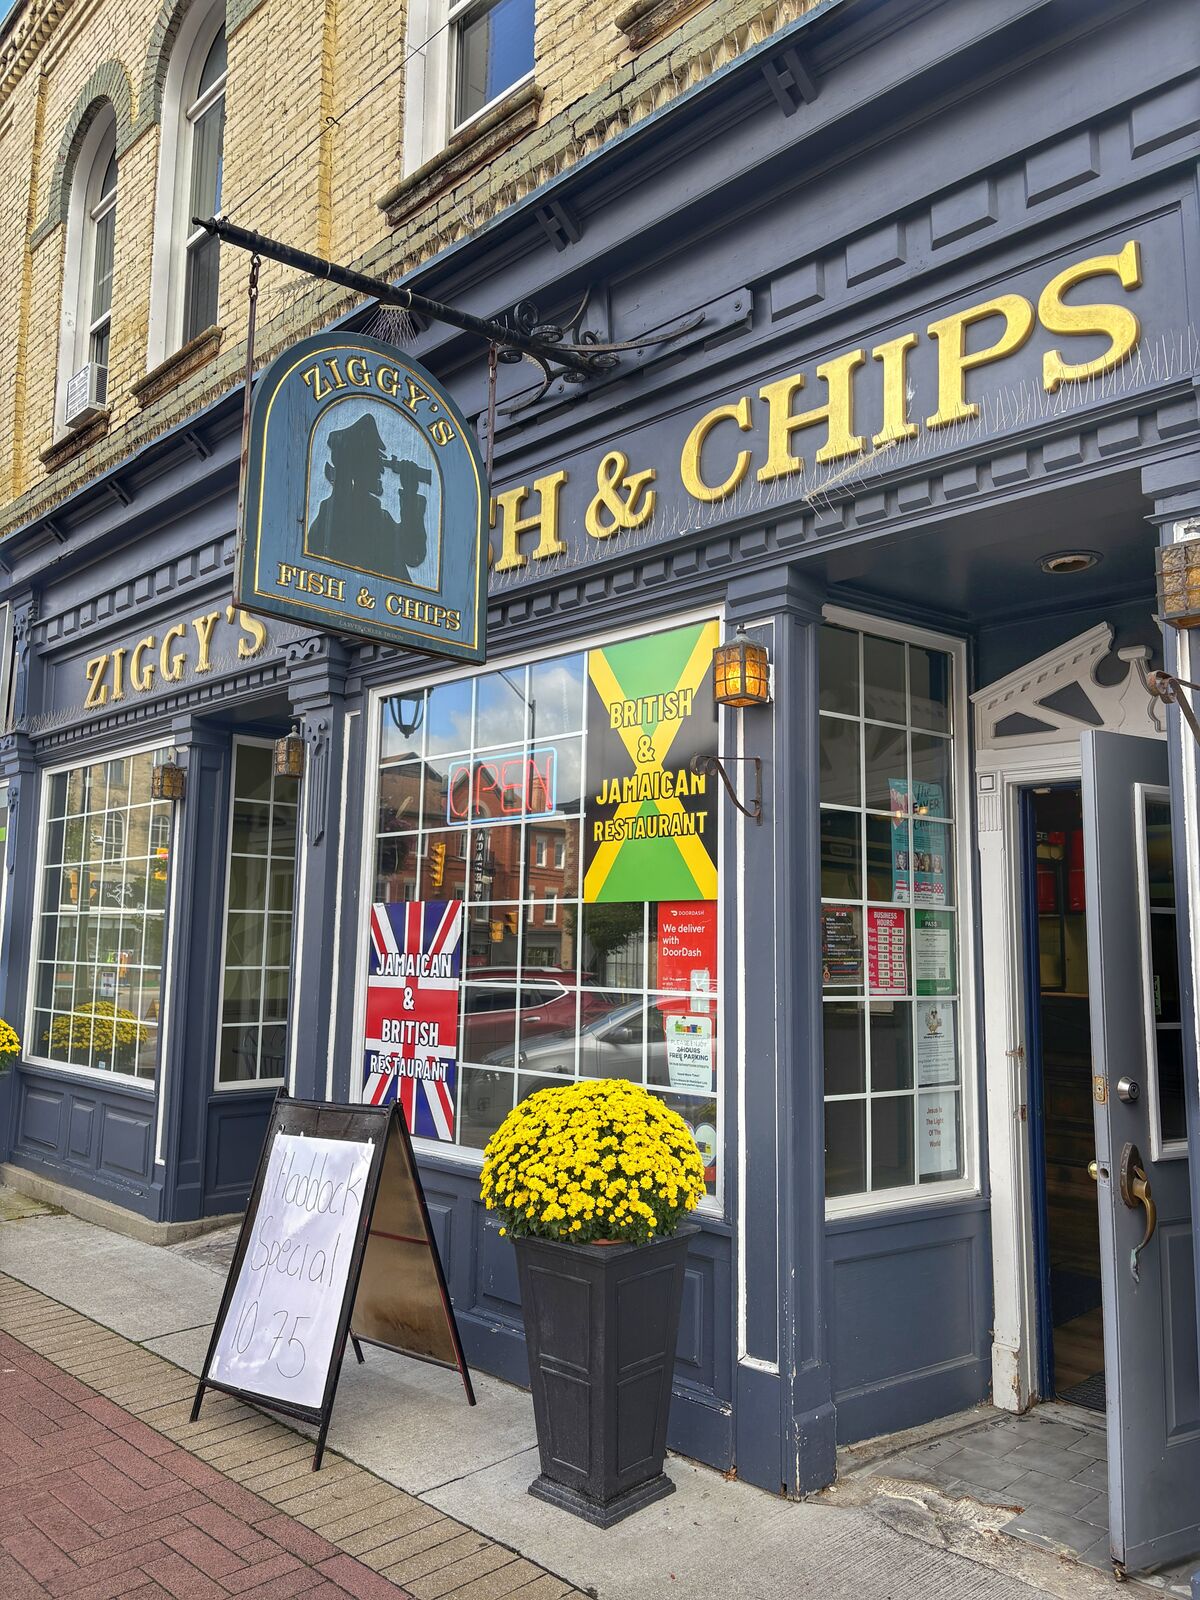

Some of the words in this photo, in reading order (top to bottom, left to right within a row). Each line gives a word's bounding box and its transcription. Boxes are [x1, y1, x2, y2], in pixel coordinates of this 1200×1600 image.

[300, 354, 456, 448] ZIGGY'S
[585, 450, 657, 539] &
[680, 240, 1143, 503] CHIPS
[276, 562, 347, 602] FISH
[356, 586, 376, 610] &
[385, 591, 462, 632] CHIPS
[83, 605, 268, 710] ZIGGY'S
[609, 687, 694, 729] BRITISH
[637, 734, 656, 763] &
[450, 755, 554, 817] OPEN
[595, 769, 707, 806] JAMAICAN
[593, 811, 708, 842] RESTAURANT
[662, 923, 677, 933] We
[678, 923, 705, 933] deliver
[873, 911, 898, 920] BUSINESS
[662, 936, 680, 945] with
[662, 947, 702, 957] DoorDash
[375, 952, 453, 979] JAMAICAN
[402, 985, 415, 1011] &
[381, 1018, 440, 1048] BRITISH
[369, 1053, 449, 1083] RESTAURANT
[683, 1053, 709, 1061] PARKING
[934, 1118, 944, 1126] Light
[273, 1151, 362, 1217] Haddock
[250, 1214, 342, 1298] Special
